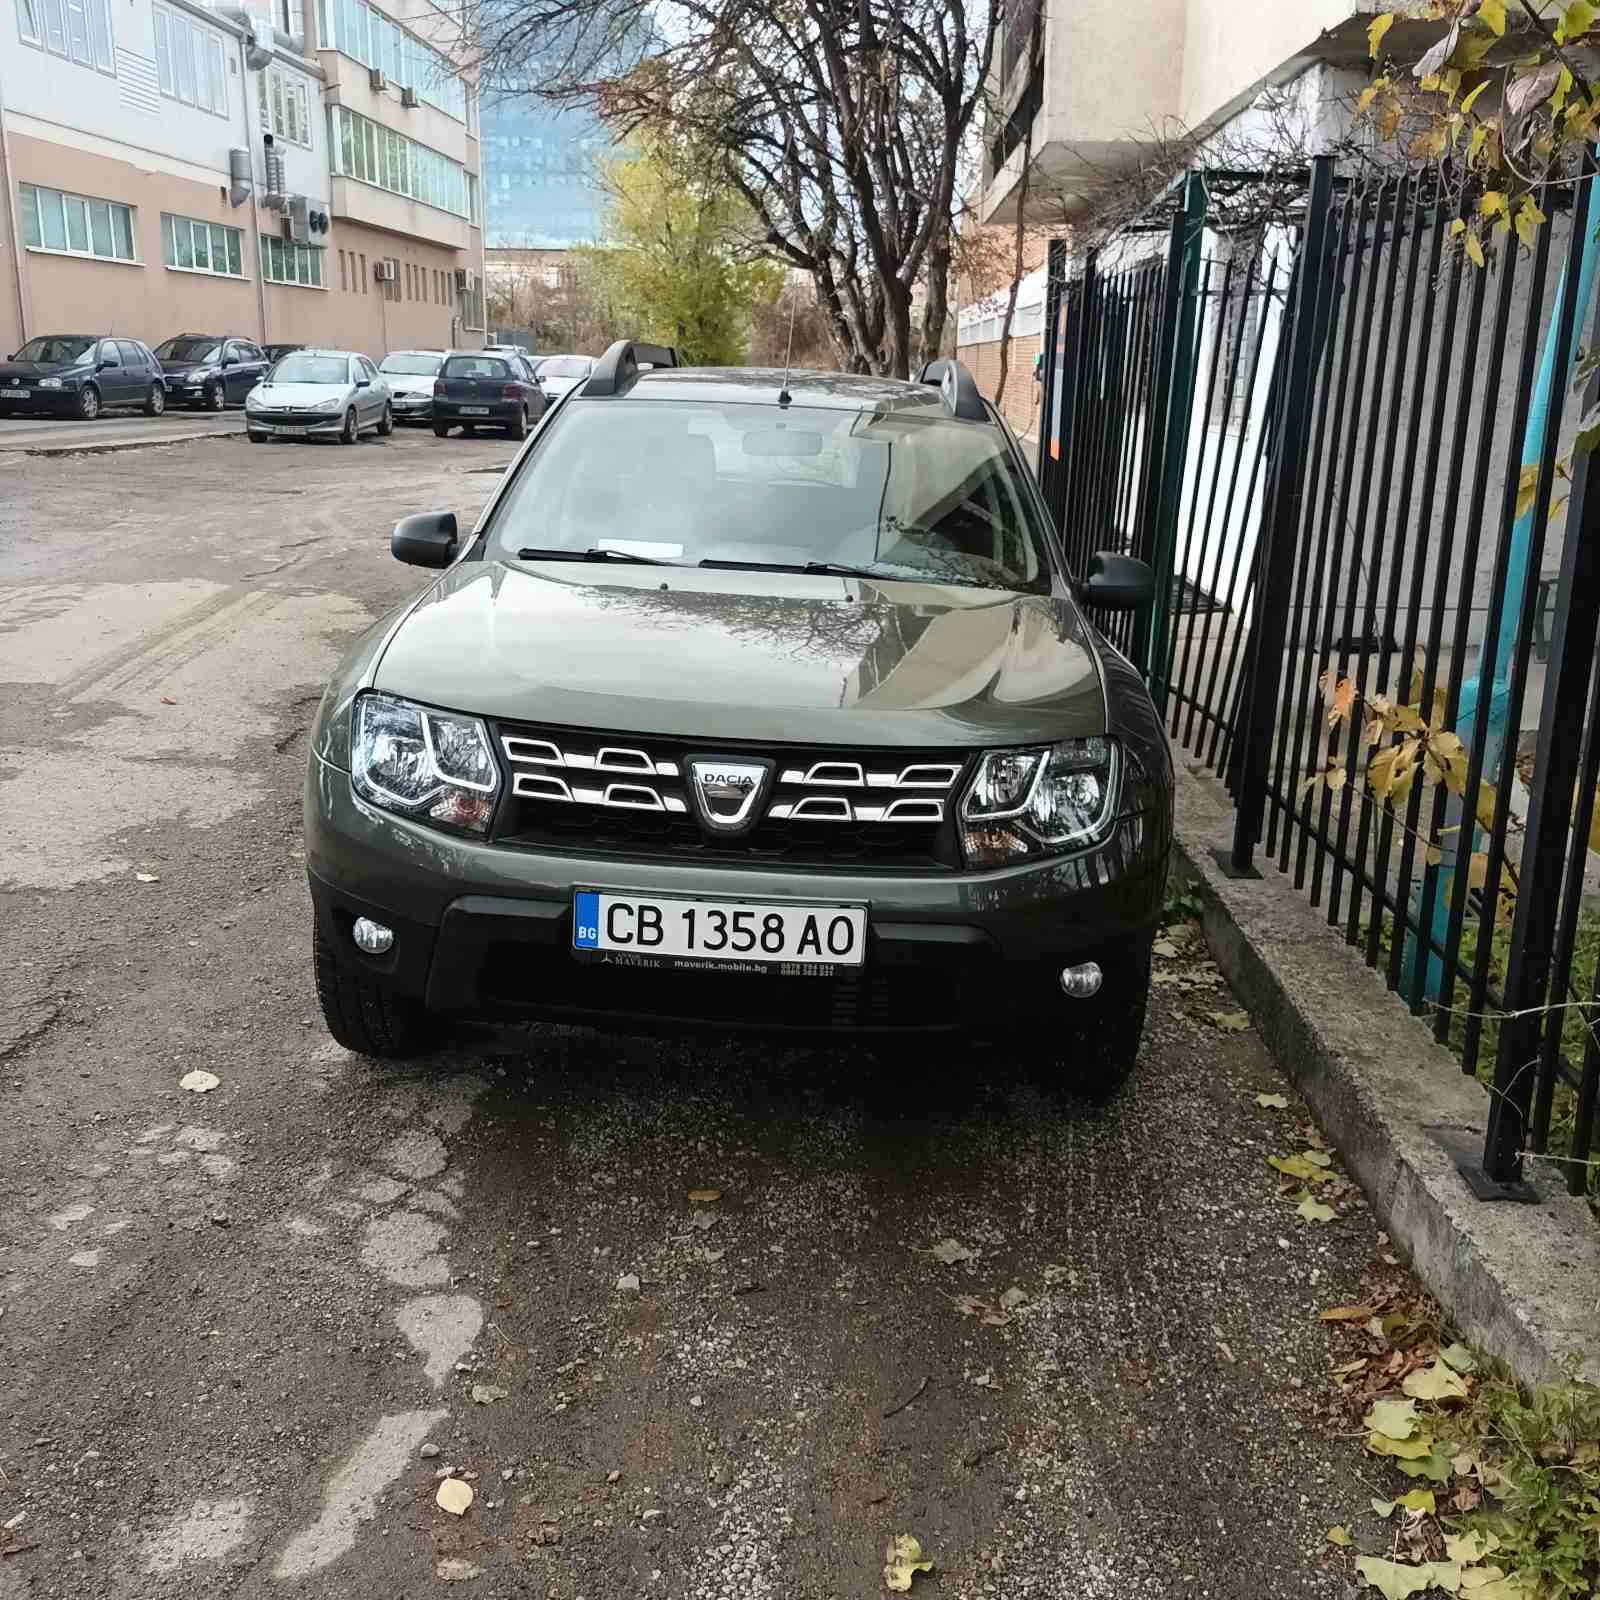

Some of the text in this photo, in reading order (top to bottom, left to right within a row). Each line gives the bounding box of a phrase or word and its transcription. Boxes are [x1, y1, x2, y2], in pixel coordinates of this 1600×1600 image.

[704, 773, 754, 785] DACIA
[578, 926, 597, 940] BG
[608, 903, 855, 956] CB 1358 AO
[615, 957, 661, 968] MAVERIK
[674, 960, 768, 974] maverik.mobile.bg
